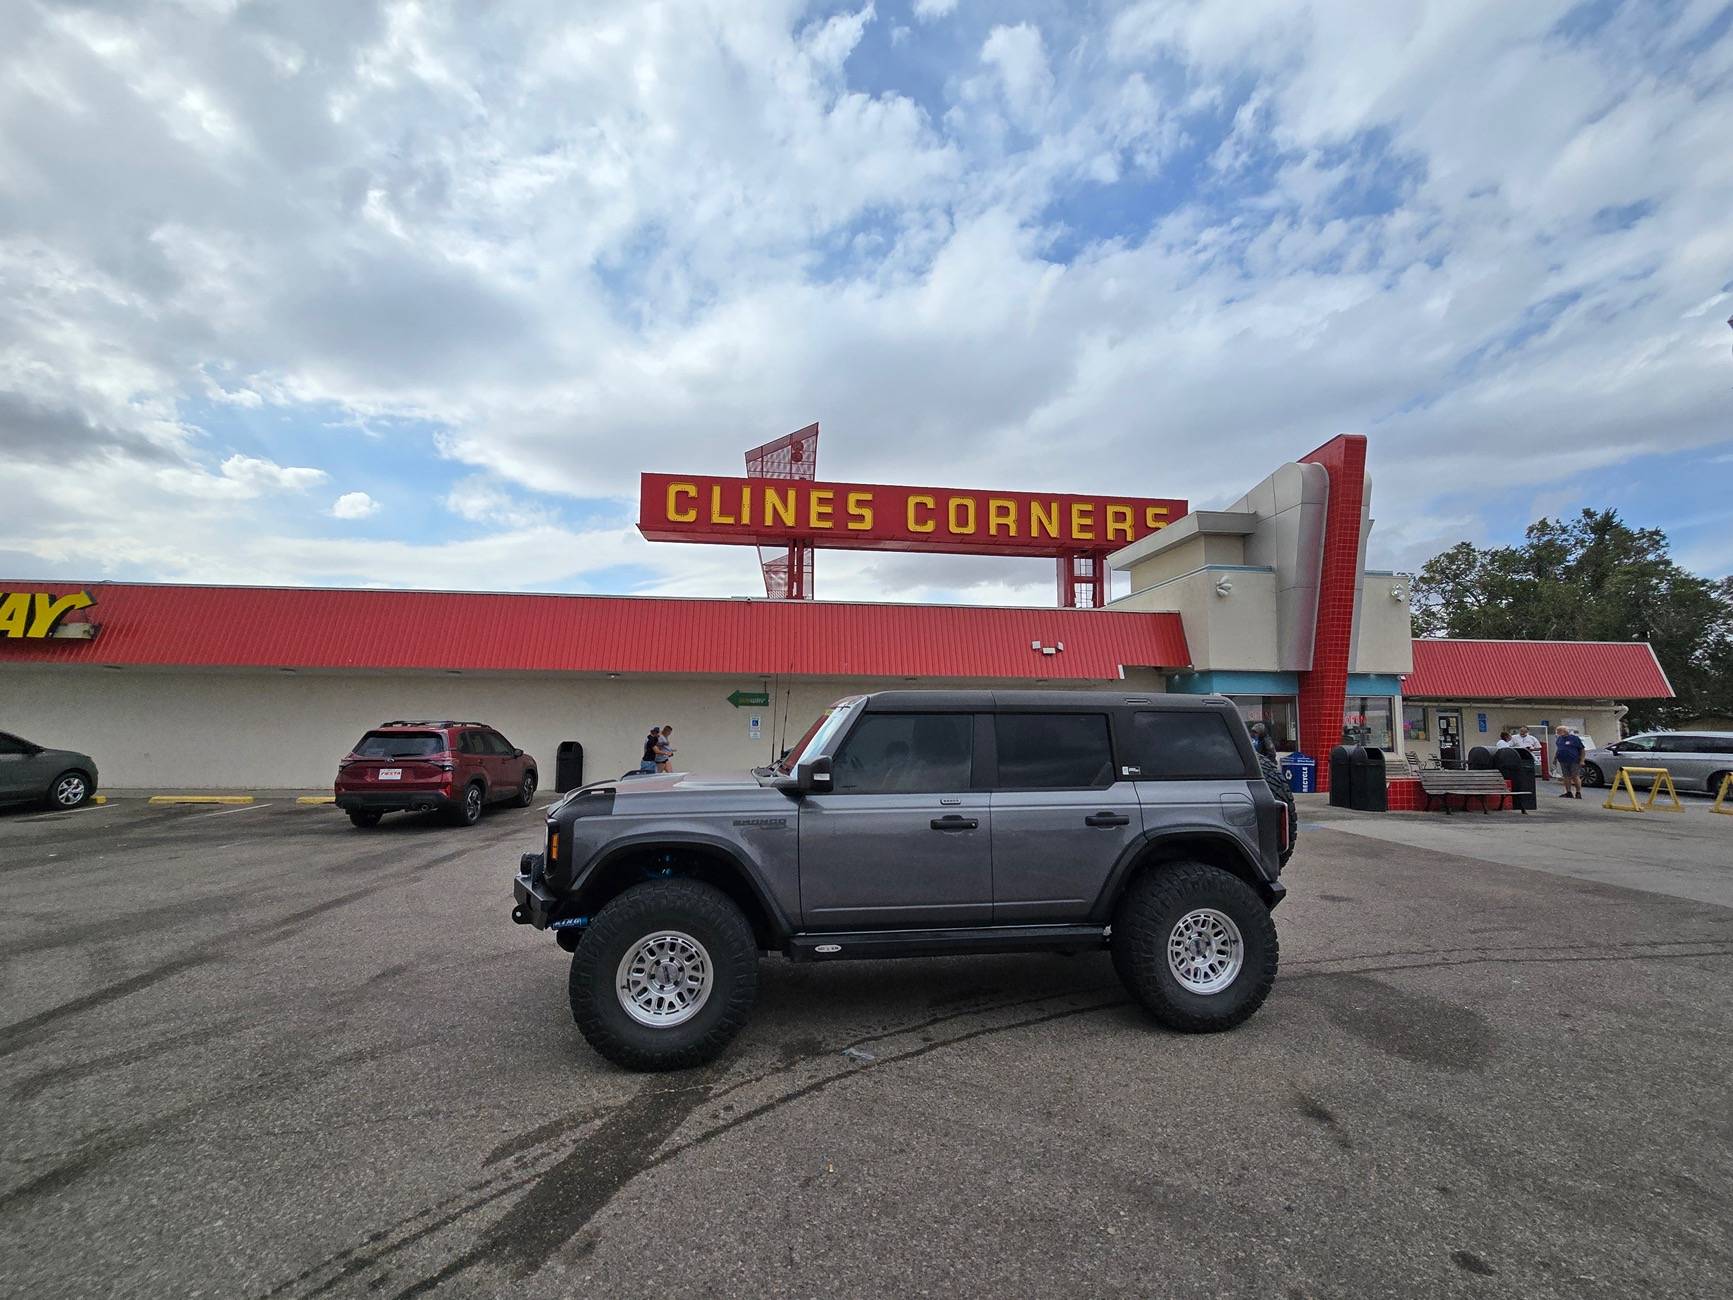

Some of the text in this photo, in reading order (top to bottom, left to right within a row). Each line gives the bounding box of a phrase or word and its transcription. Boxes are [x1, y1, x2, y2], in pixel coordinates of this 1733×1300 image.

[666, 482, 1169, 541] CLINES CORNERS
[0, 591, 94, 638] AY
